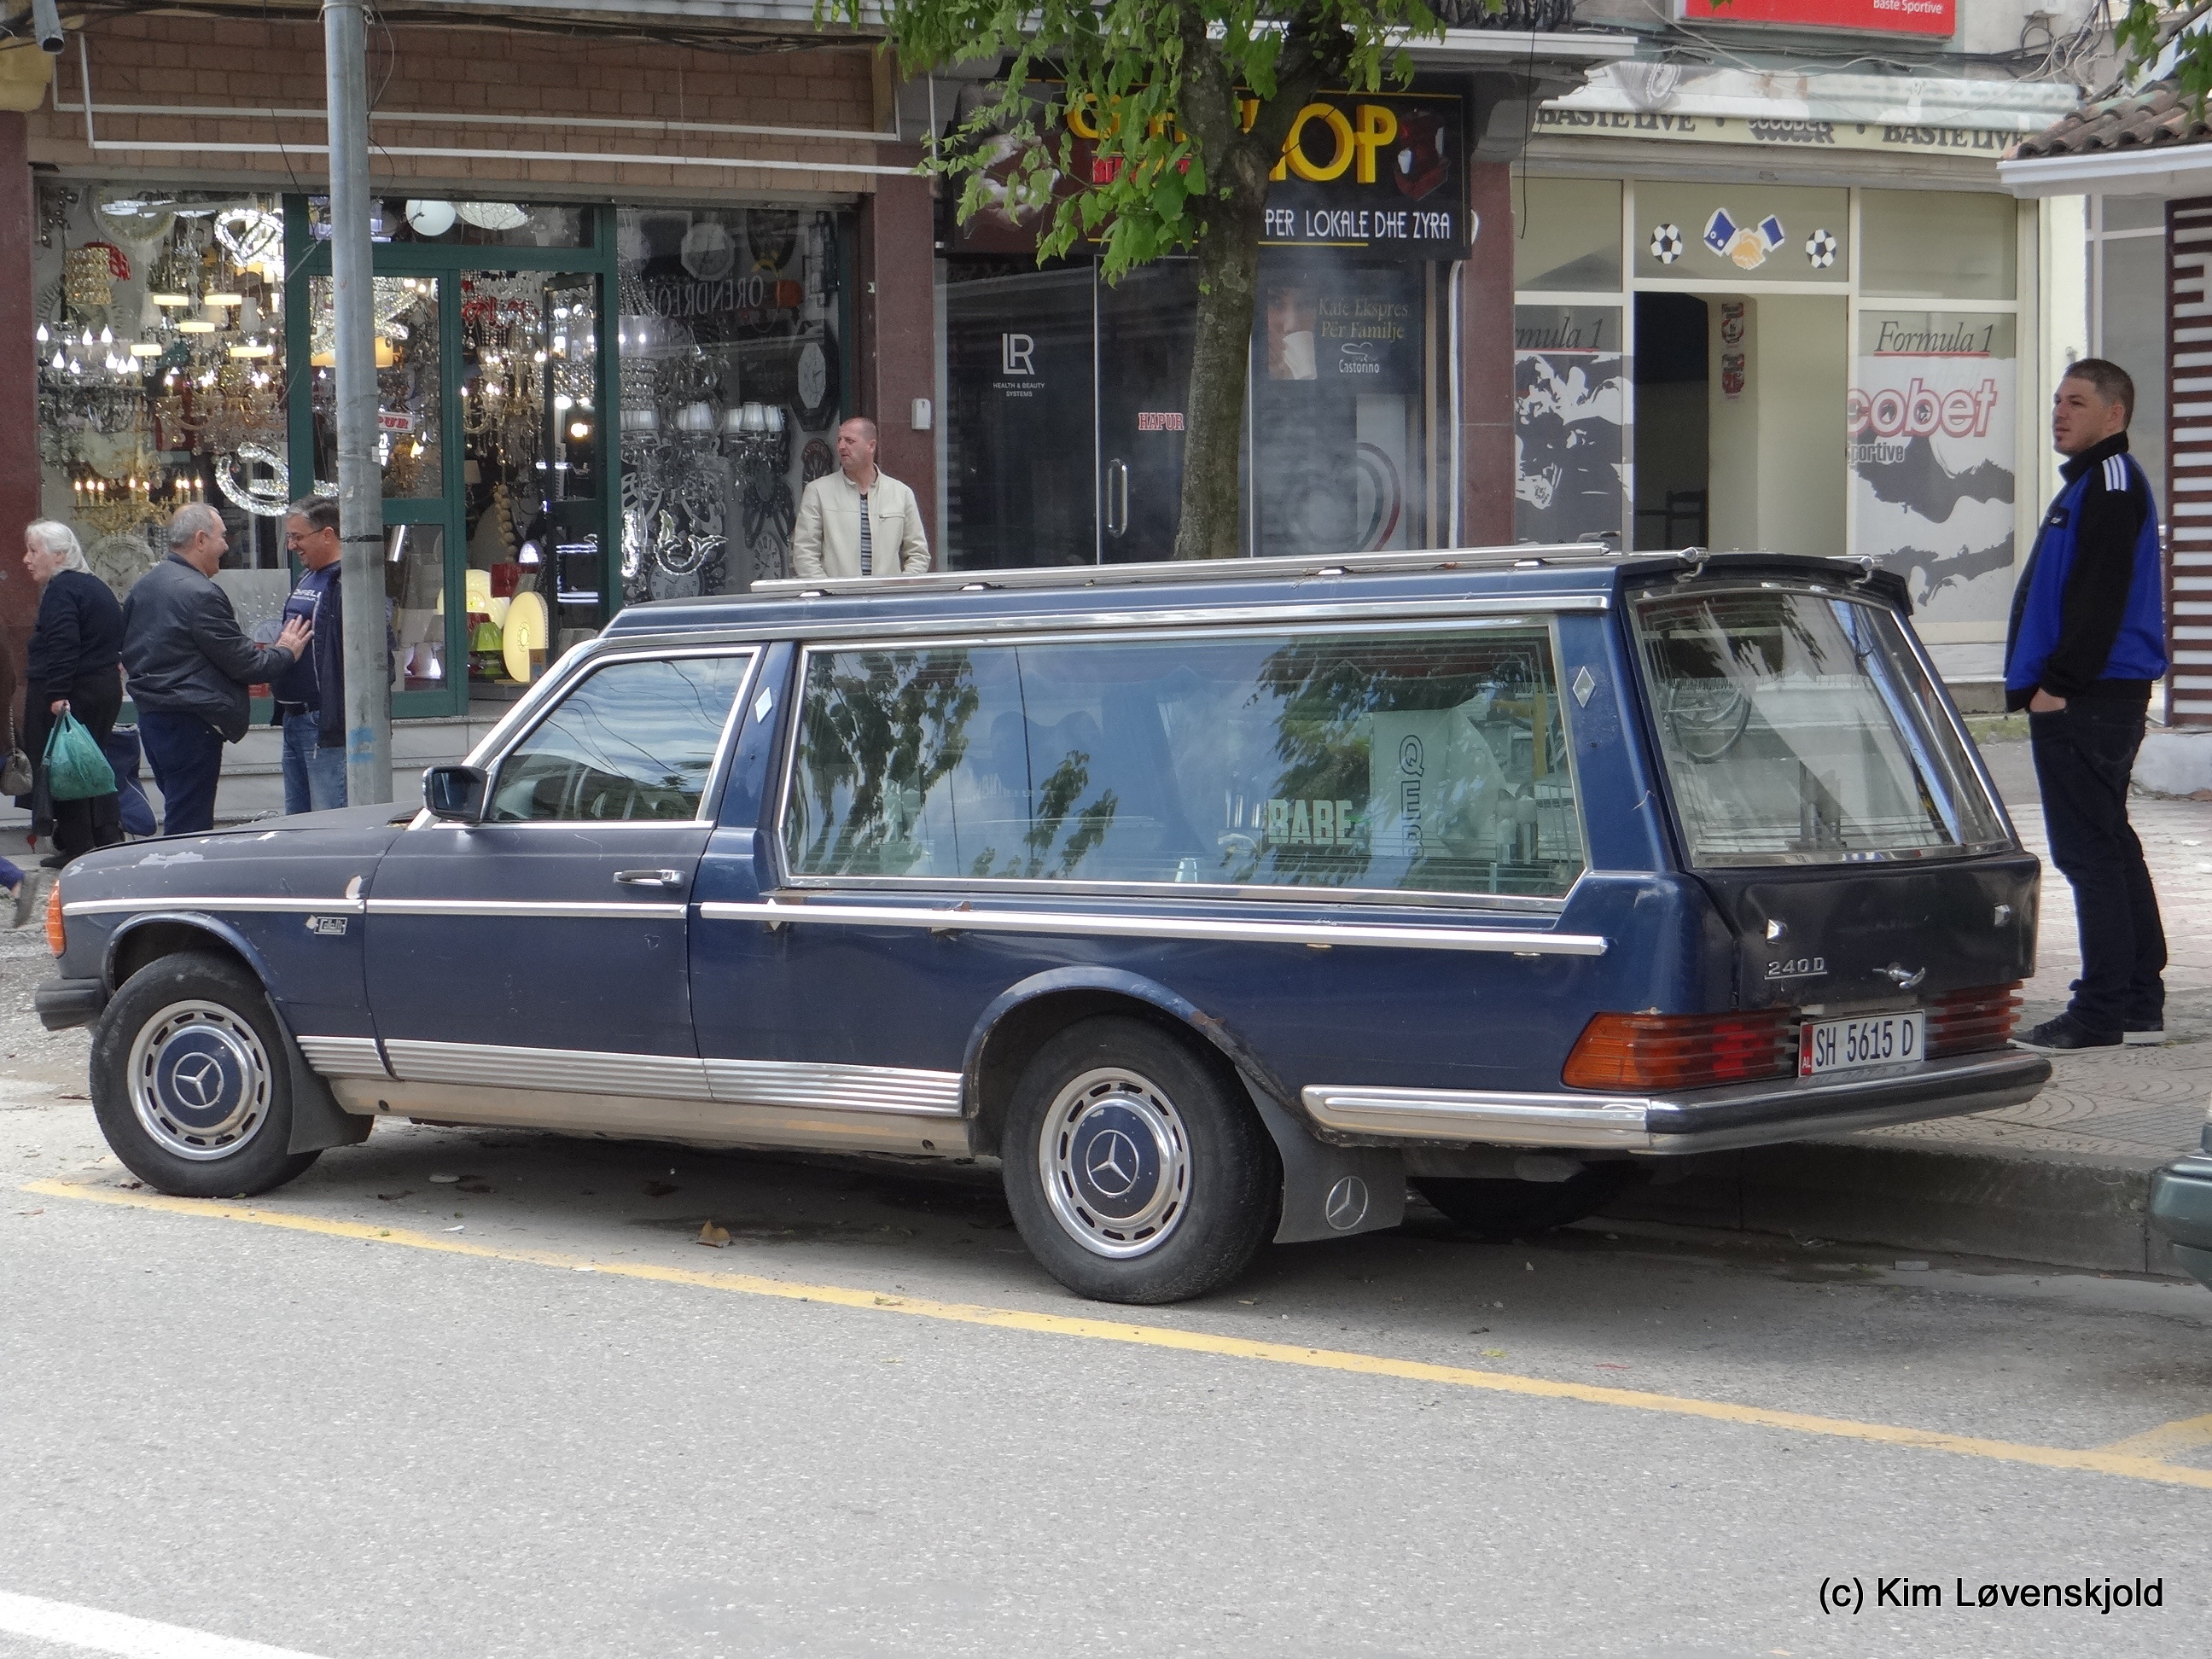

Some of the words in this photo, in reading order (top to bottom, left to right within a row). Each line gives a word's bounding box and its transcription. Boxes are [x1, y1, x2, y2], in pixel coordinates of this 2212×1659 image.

[1873, 0, 1900, 10] Baste
[1901, 0, 1943, 15] Sportive
[1265, 209, 1295, 236] PER
[1306, 210, 1369, 238] LOKALE
[1375, 212, 1408, 239] DHE
[1412, 212, 1450, 239] ZYRA
[1354, 297, 1408, 321] Ekspres
[1350, 322, 1405, 343] Familje
[1874, 321, 1975, 352] Formula
[1981, 323, 1994, 352] 1
[1002, 333, 1035, 375] LR
[1339, 358, 1381, 373] Castorino
[1138, 412, 1185, 431] HAPUR
[1848, 440, 1905, 465] portive
[1815, 1027, 1837, 1067] SH
[1847, 1020, 1893, 1062] 5615
[1902, 1019, 1913, 1057] D
[1802, 1056, 1811, 1069] AL
